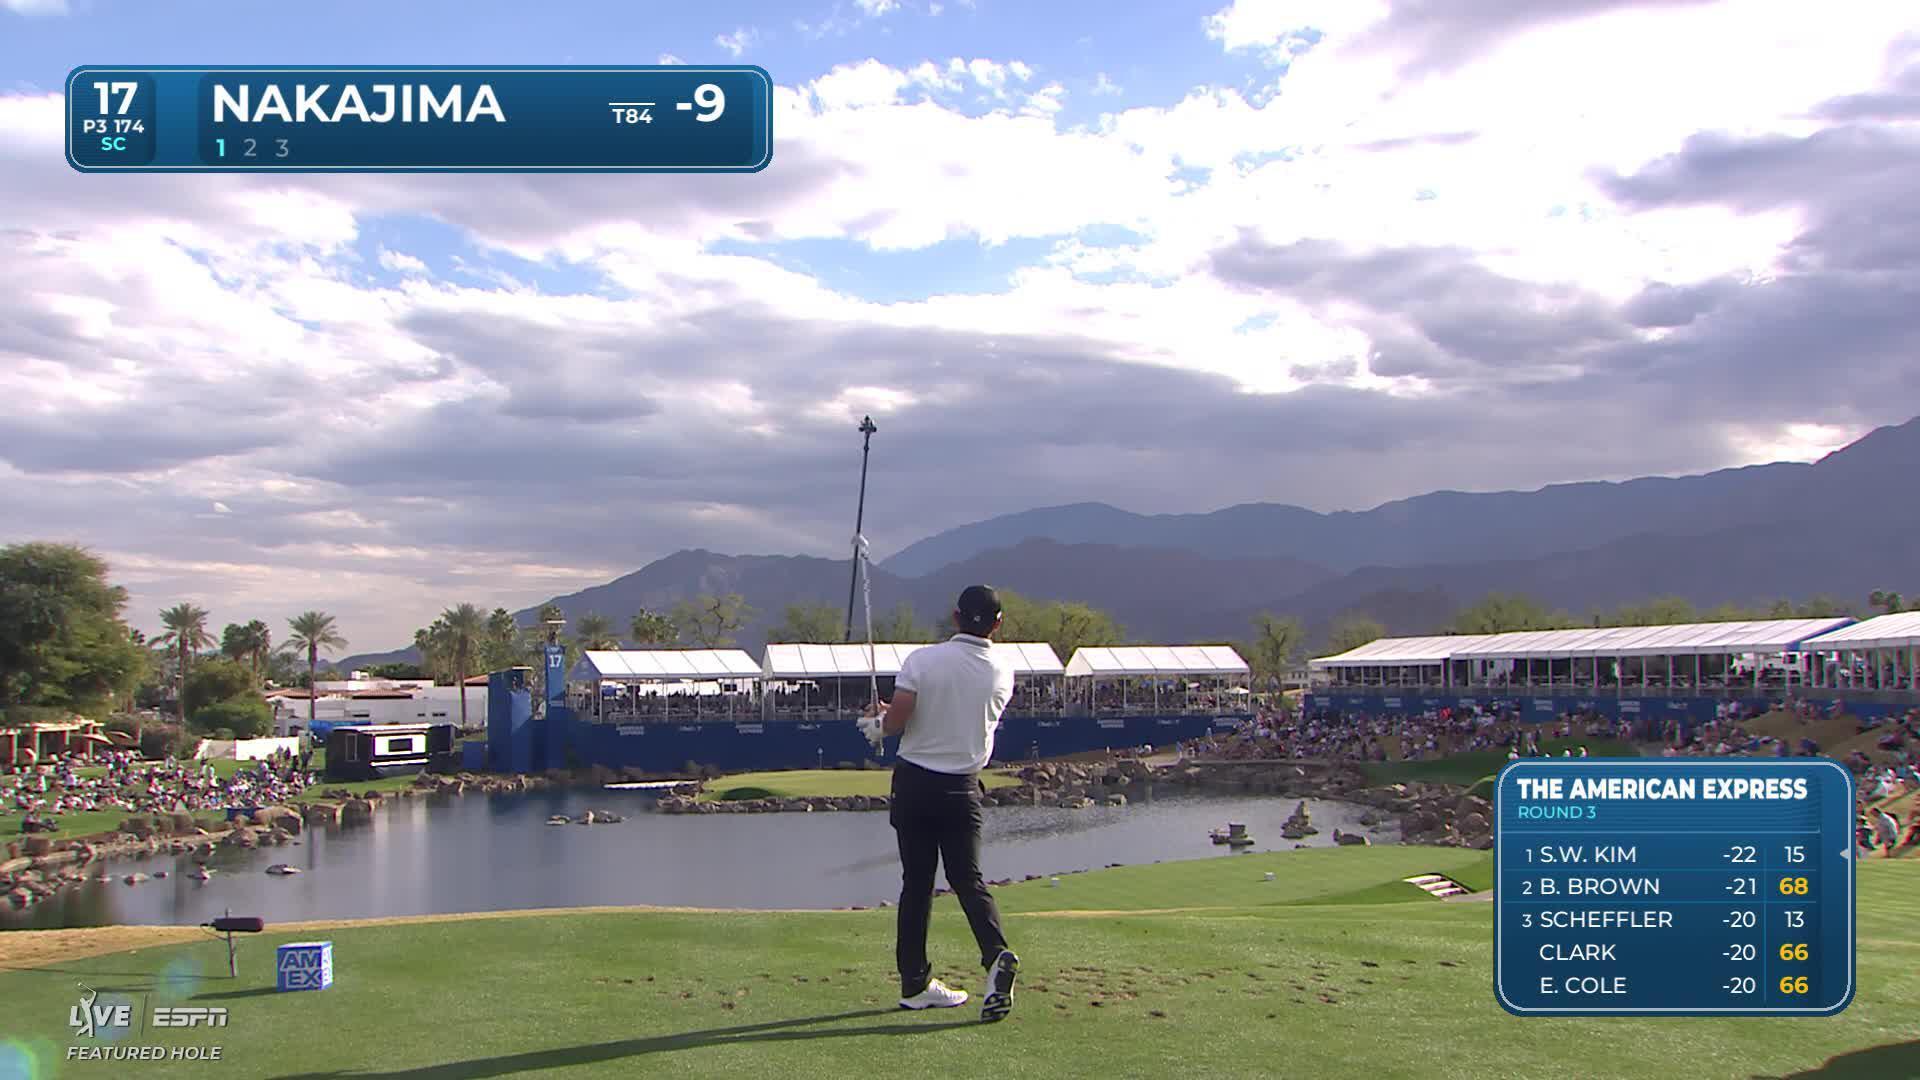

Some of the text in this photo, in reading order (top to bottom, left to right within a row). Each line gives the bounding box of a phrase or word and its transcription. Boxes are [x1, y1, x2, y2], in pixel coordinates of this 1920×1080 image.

[549, 655, 561, 668] 17
[280, 950, 320, 971] AM
[286, 969, 321, 988] EX
